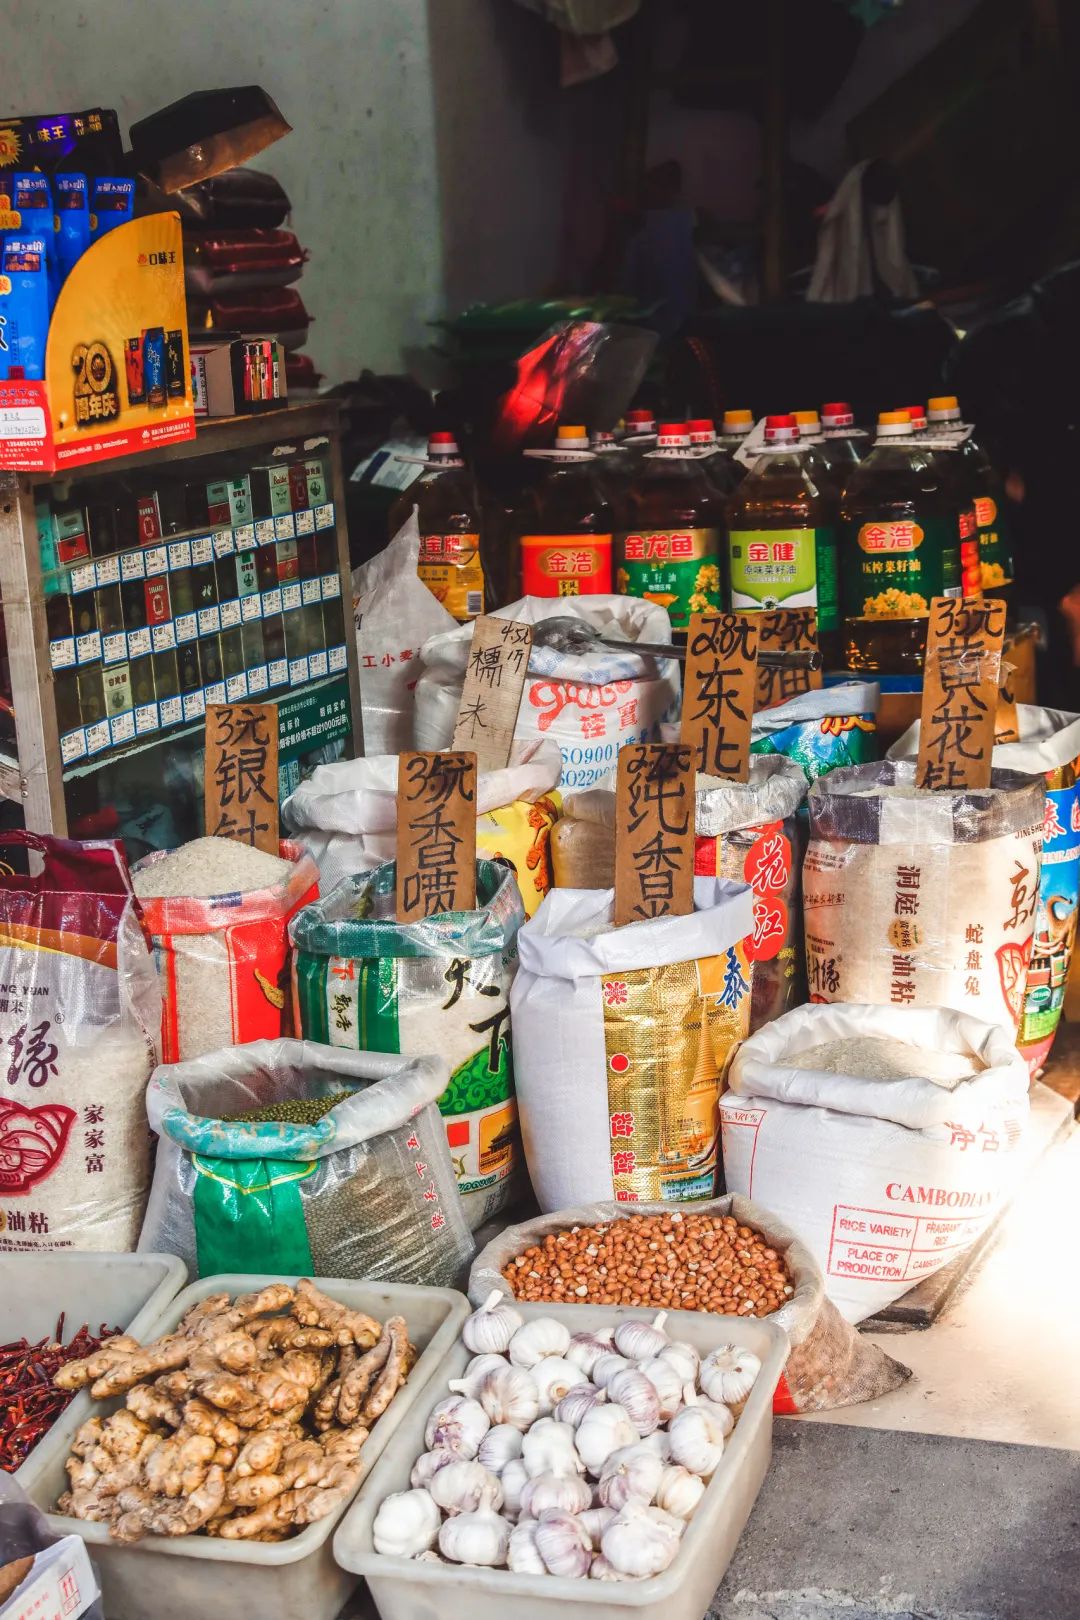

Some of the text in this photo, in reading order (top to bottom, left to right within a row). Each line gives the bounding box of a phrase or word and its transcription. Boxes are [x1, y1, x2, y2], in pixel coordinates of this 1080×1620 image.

[625, 535, 693, 559] 金龙鱼
[748, 543, 795, 562] 金健
[866, 525, 913, 548] 金浩
[548, 551, 593, 573] 金浩
[934, 600, 1004, 638] 3.5元
[214, 709, 271, 747] 3元
[690, 661, 749, 783] 东北
[211, 747, 275, 848] 银针
[407, 756, 473, 803] 3.5元
[894, 864, 921, 915] 洞庭
[1003, 860, 1041, 931] 京
[964, 922, 984, 996] 蛇盘兔
[83, 1104, 105, 1174] 家家富
[839, 1218, 912, 1238] RICE VARIETY
[837, 1260, 902, 1277] PRODUCTION
[847, 1247, 899, 1263] PLACE OF
